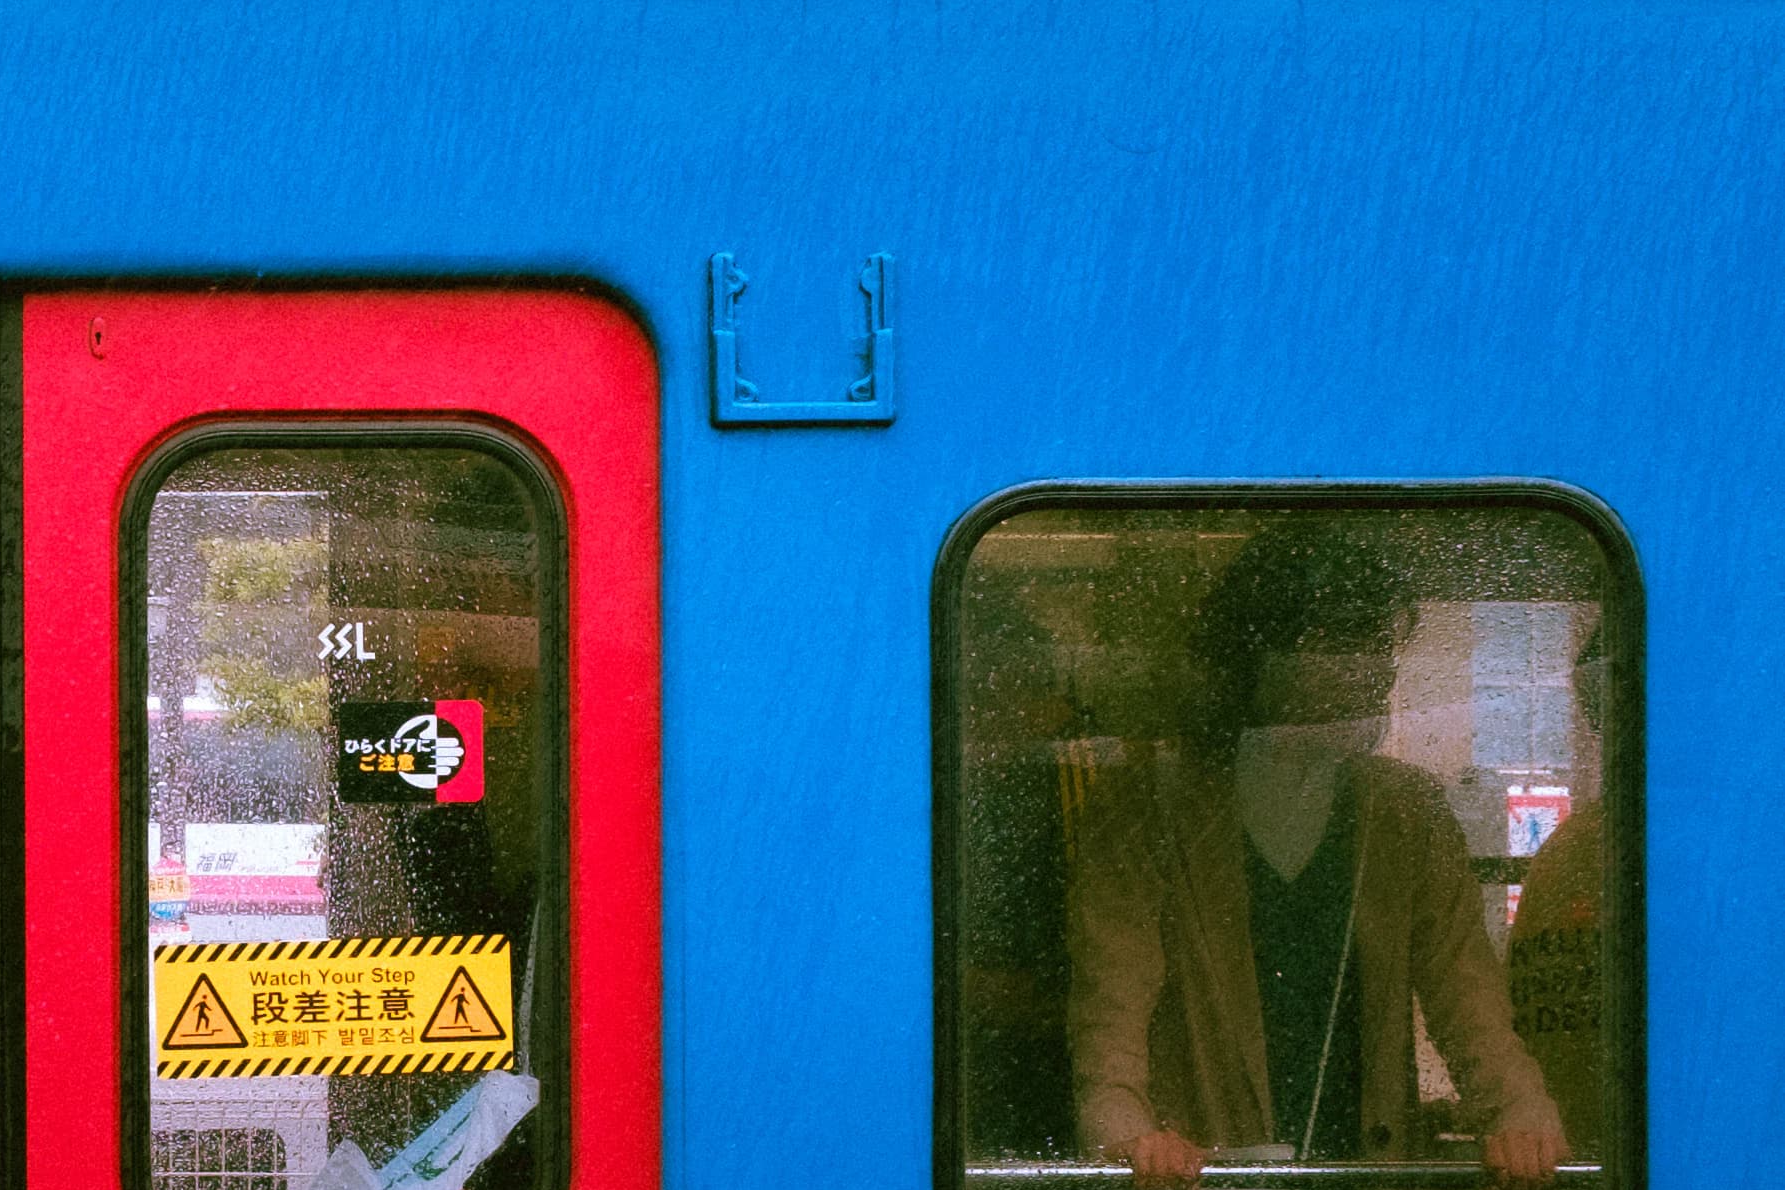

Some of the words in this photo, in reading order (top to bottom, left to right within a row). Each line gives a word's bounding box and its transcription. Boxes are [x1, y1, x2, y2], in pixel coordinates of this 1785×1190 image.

[318, 622, 375, 660] SSL
[344, 738, 431, 754] ひらくドアに
[359, 753, 415, 772] ご注意
[250, 970, 311, 986] Watch
[318, 969, 363, 985] Your
[371, 967, 415, 985] Step
[251, 987, 415, 1025] 段差注意
[252, 1029, 328, 1047] 注意脚下
[338, 1026, 415, 1046] 발밑조심
